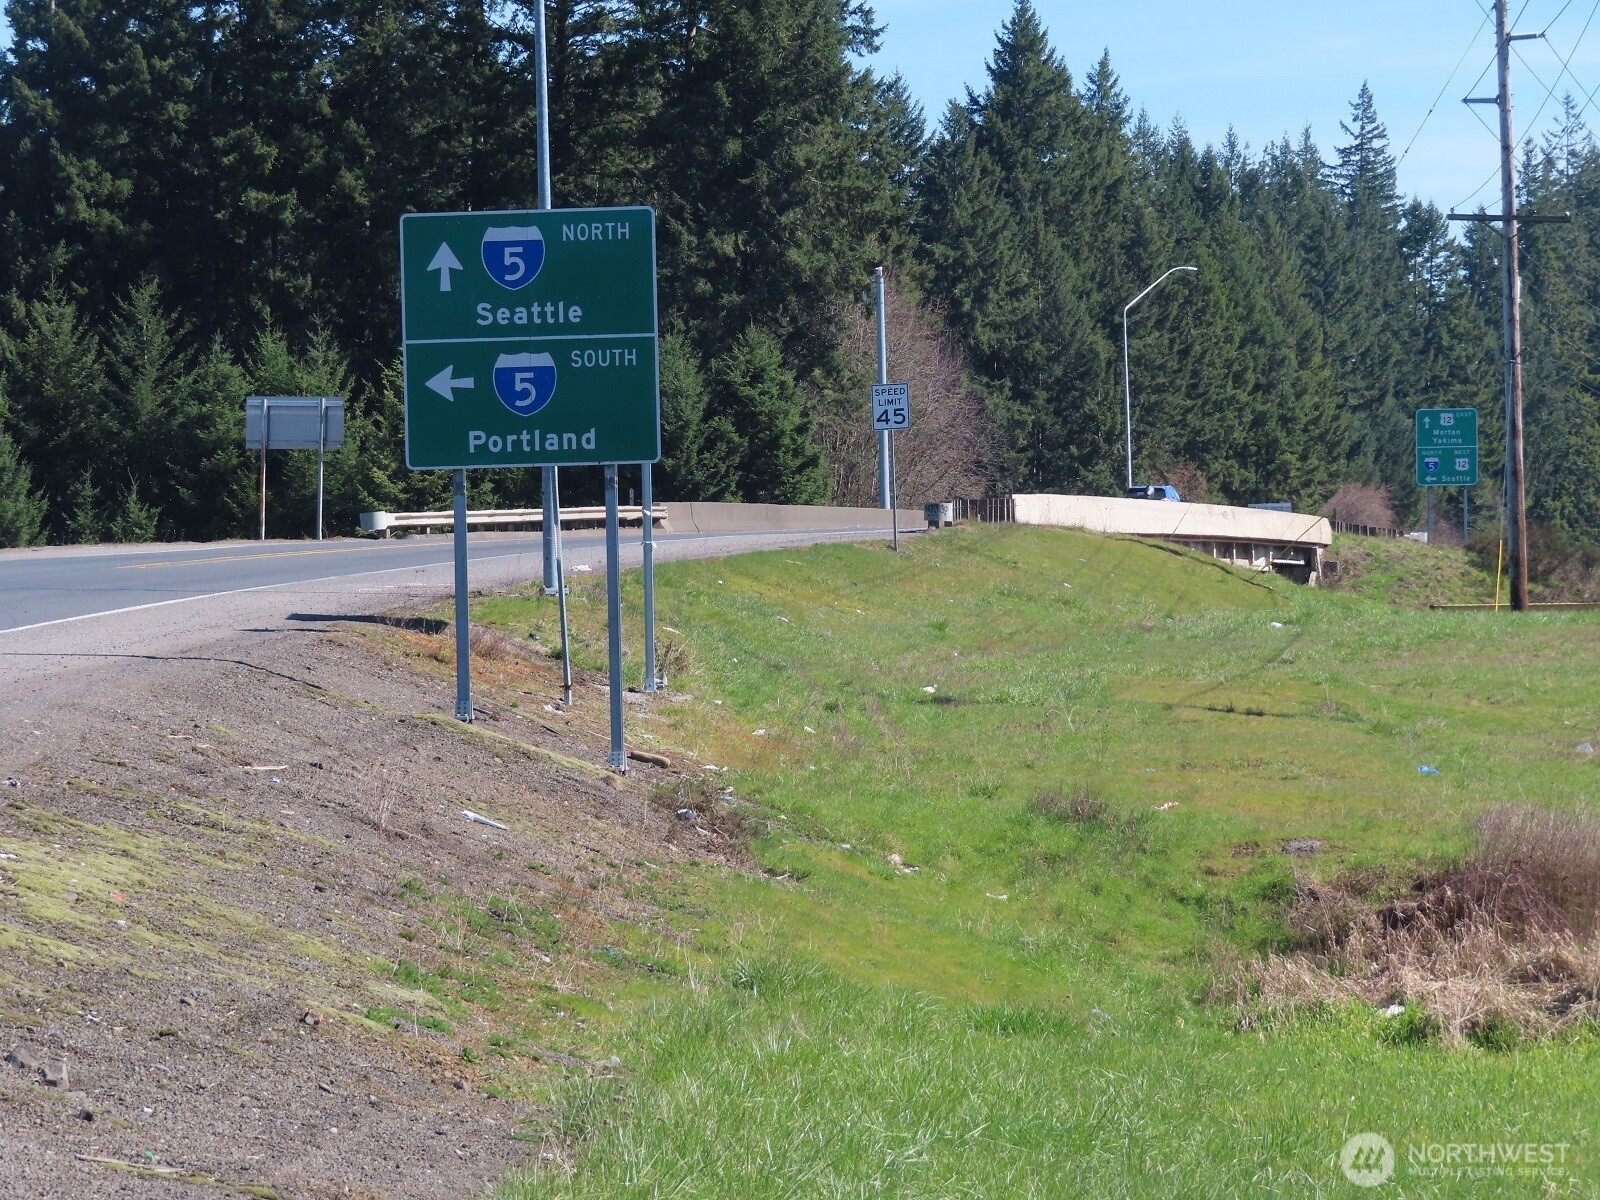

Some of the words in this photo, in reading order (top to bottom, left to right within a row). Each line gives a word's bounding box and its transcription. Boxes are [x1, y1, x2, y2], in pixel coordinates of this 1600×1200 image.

[562, 222, 630, 241] NORTH
[503, 246, 526, 281] 5
[476, 301, 583, 326] Seattle
[571, 348, 637, 368] SOUTH
[514, 371, 537, 407] 5
[874, 387, 906, 397] SPEED
[878, 398, 903, 407] LIMIT
[876, 408, 906, 425] 45
[1442, 416, 1452, 424] 12
[468, 427, 596, 453] Portland
[1428, 462, 1435, 471] 5
[1457, 460, 1467, 468] 12
